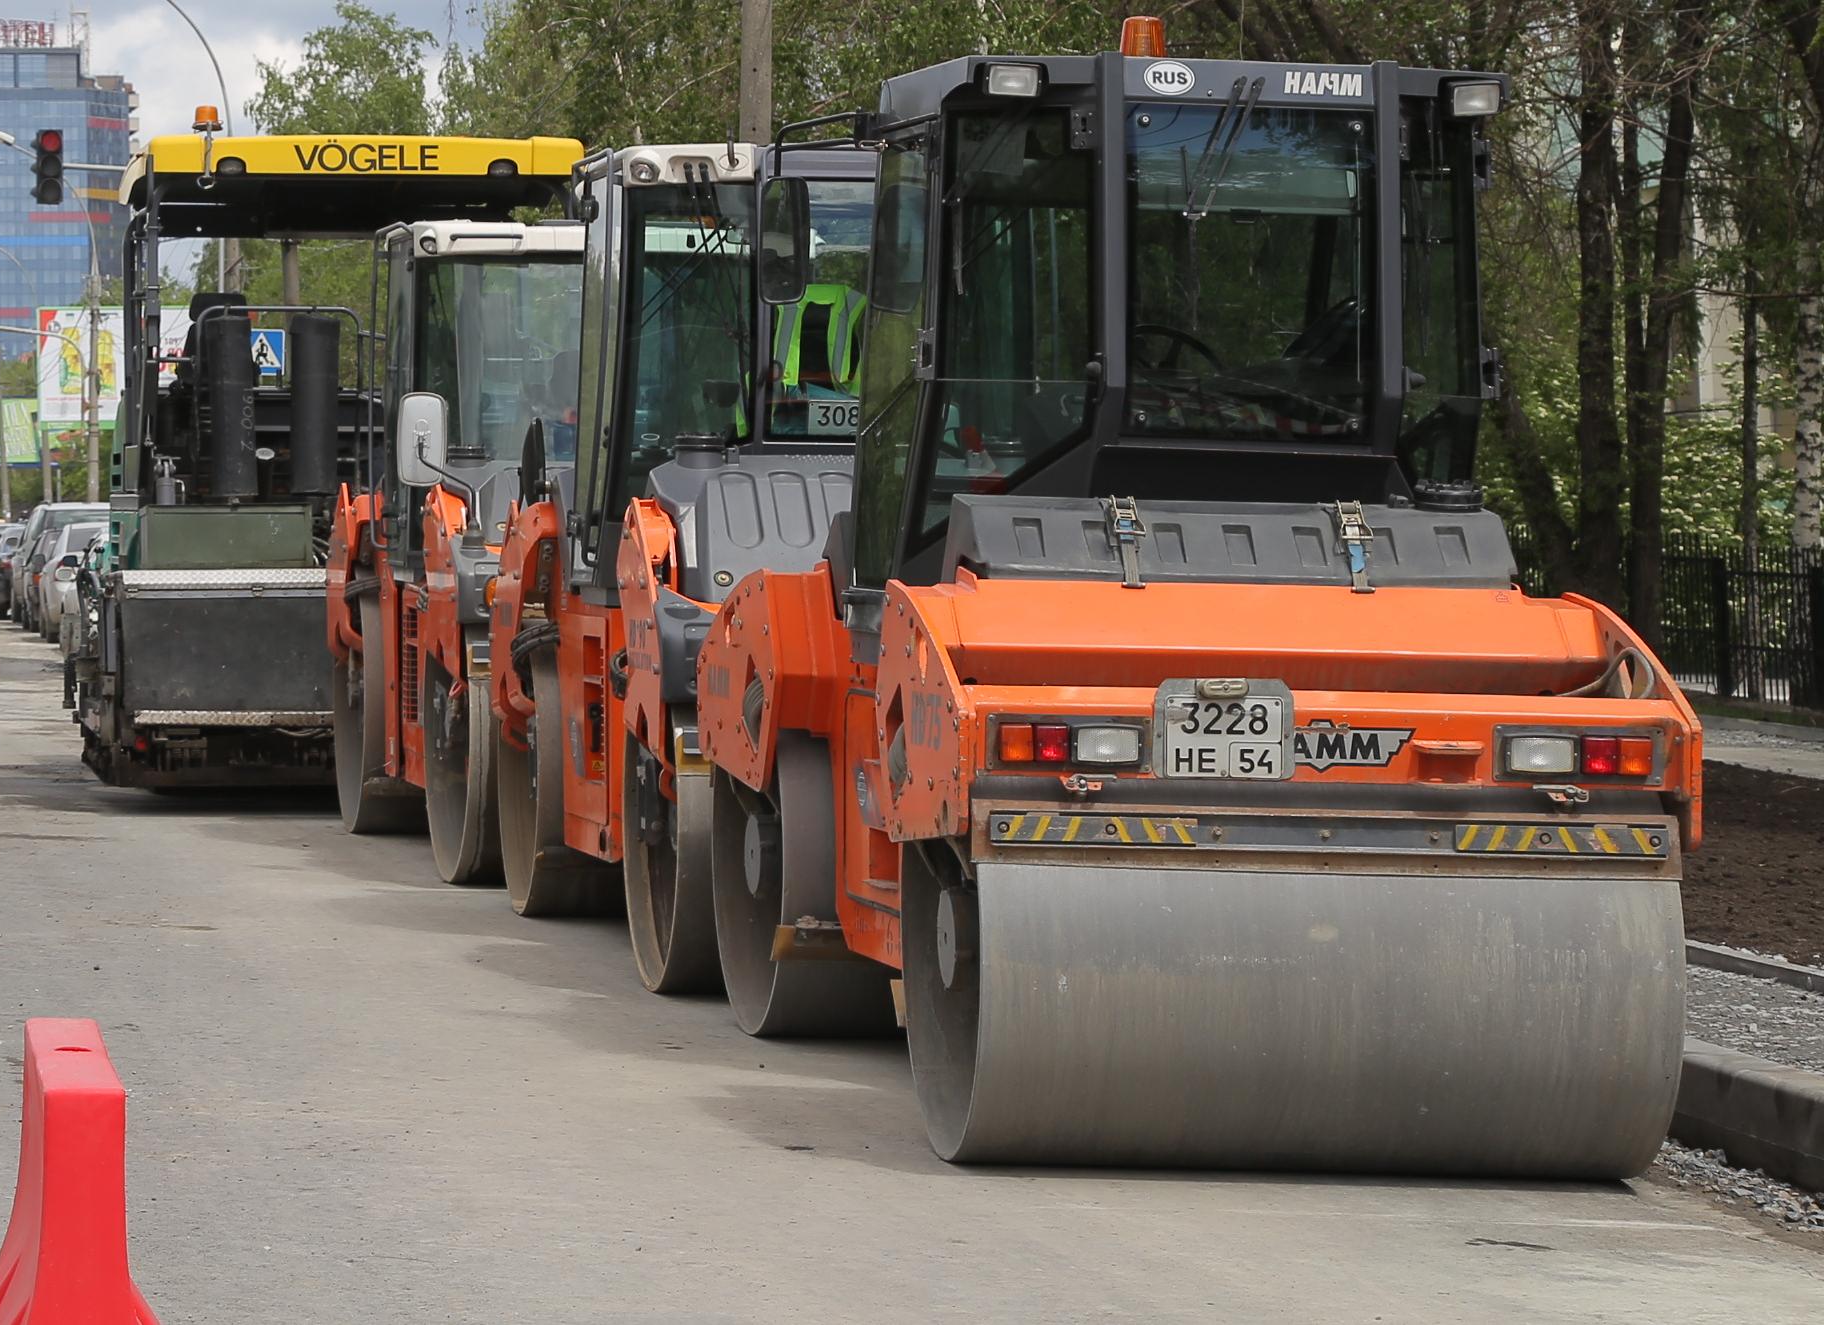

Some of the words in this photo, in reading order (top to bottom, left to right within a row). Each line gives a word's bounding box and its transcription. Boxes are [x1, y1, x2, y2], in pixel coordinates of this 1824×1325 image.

[1152, 72, 1188, 85] RUS
[1284, 71, 1363, 97] HAMM
[293, 139, 440, 172] VÖGELE
[817, 405, 859, 427] 308
[1181, 703, 1268, 735] 3228
[1294, 731, 1381, 761] AMM
[1238, 748, 1273, 774] 54
